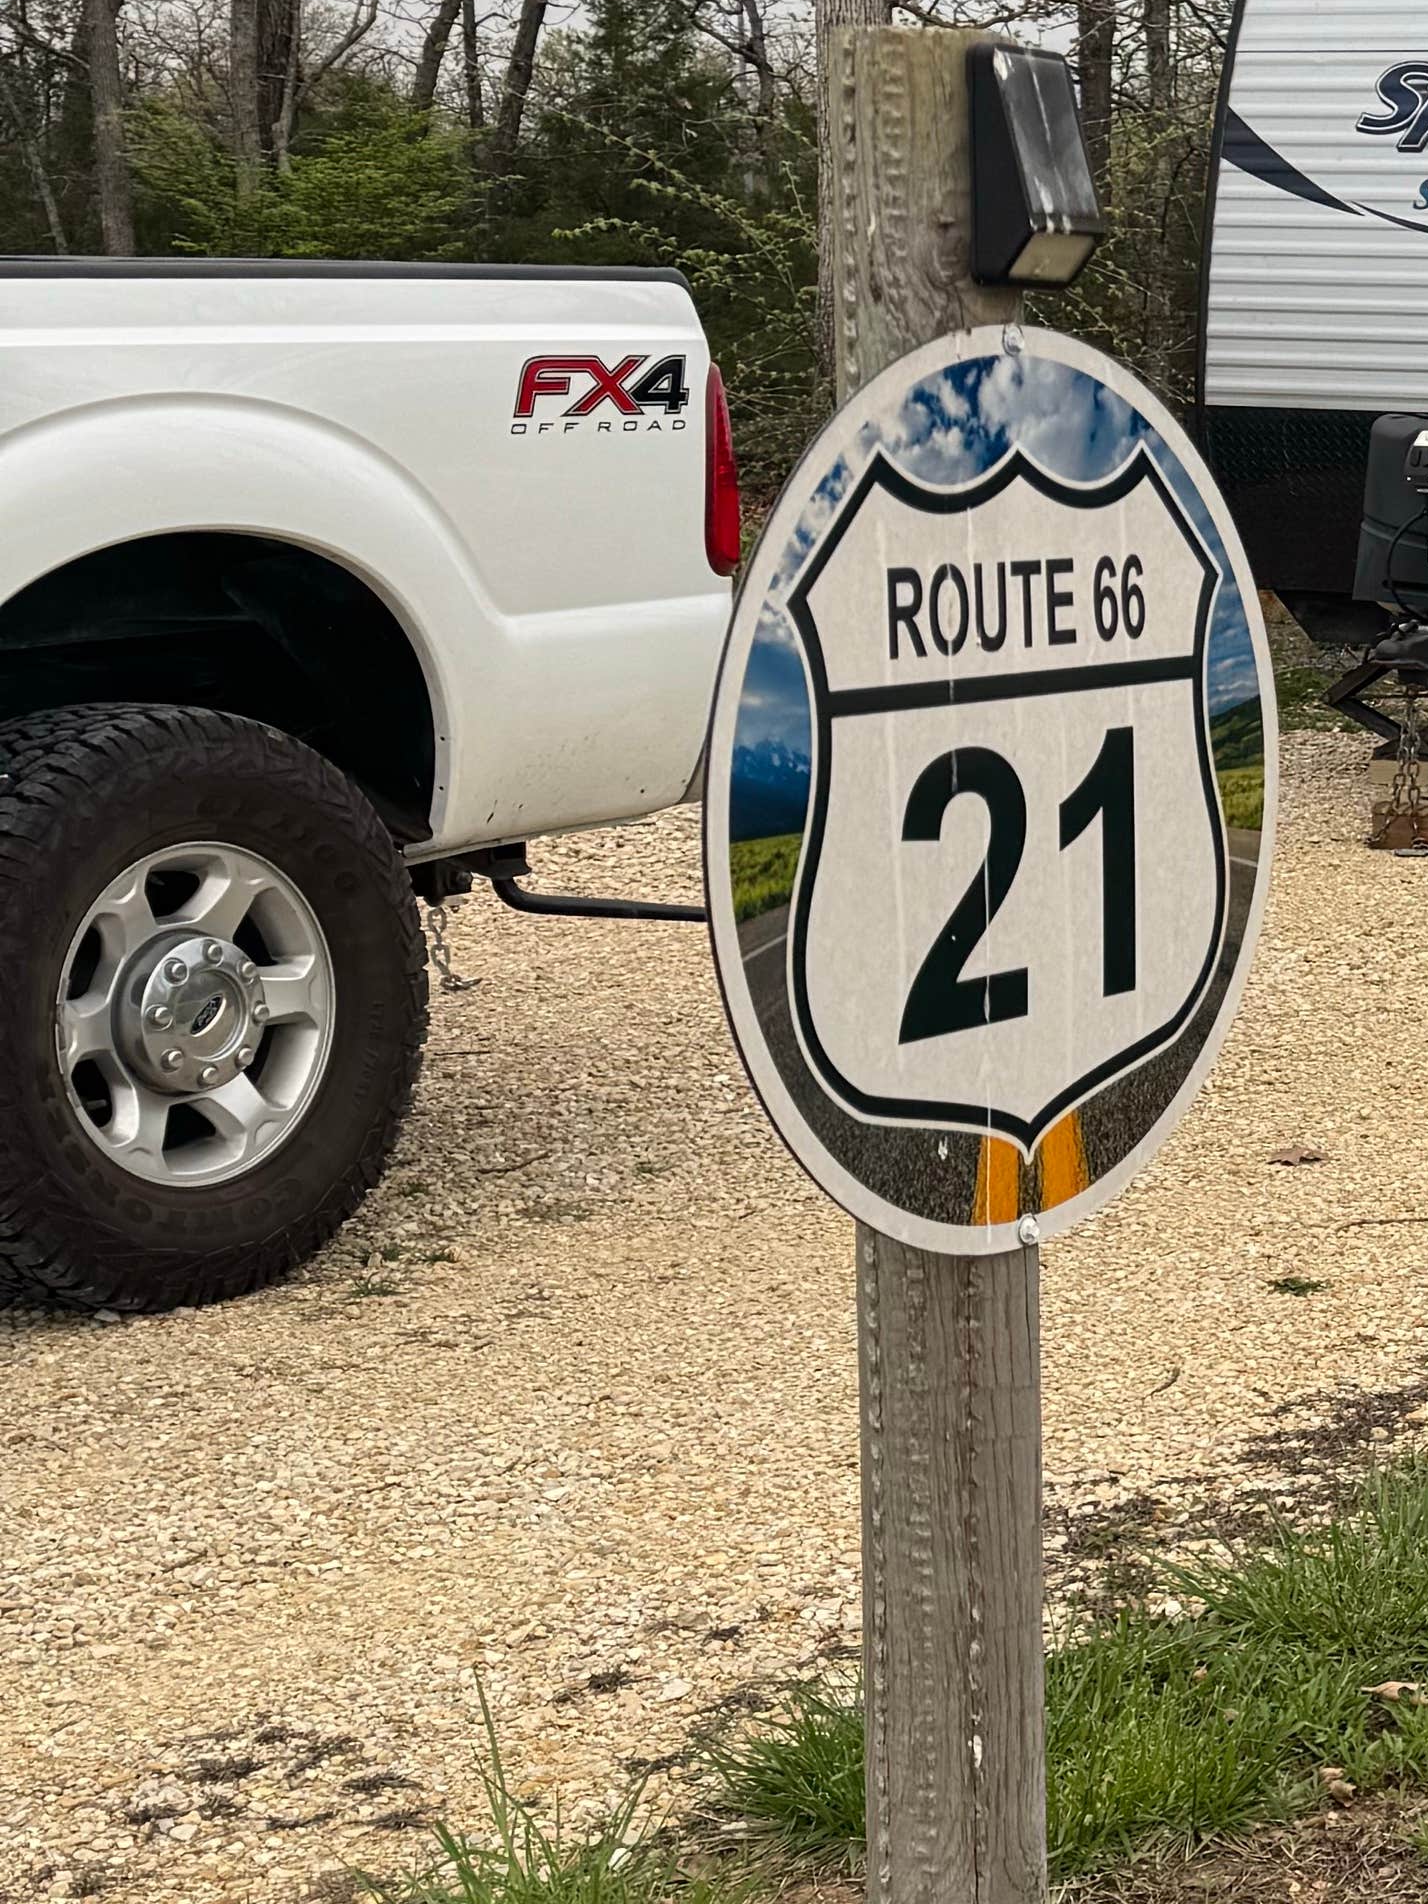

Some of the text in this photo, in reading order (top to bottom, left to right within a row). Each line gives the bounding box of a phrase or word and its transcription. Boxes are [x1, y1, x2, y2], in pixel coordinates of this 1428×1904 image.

[510, 420, 687, 435] OFF ROAD
[513, 354, 690, 418] FX4
[886, 554, 1146, 660] ROUTE 66
[898, 726, 1137, 1044] 21
